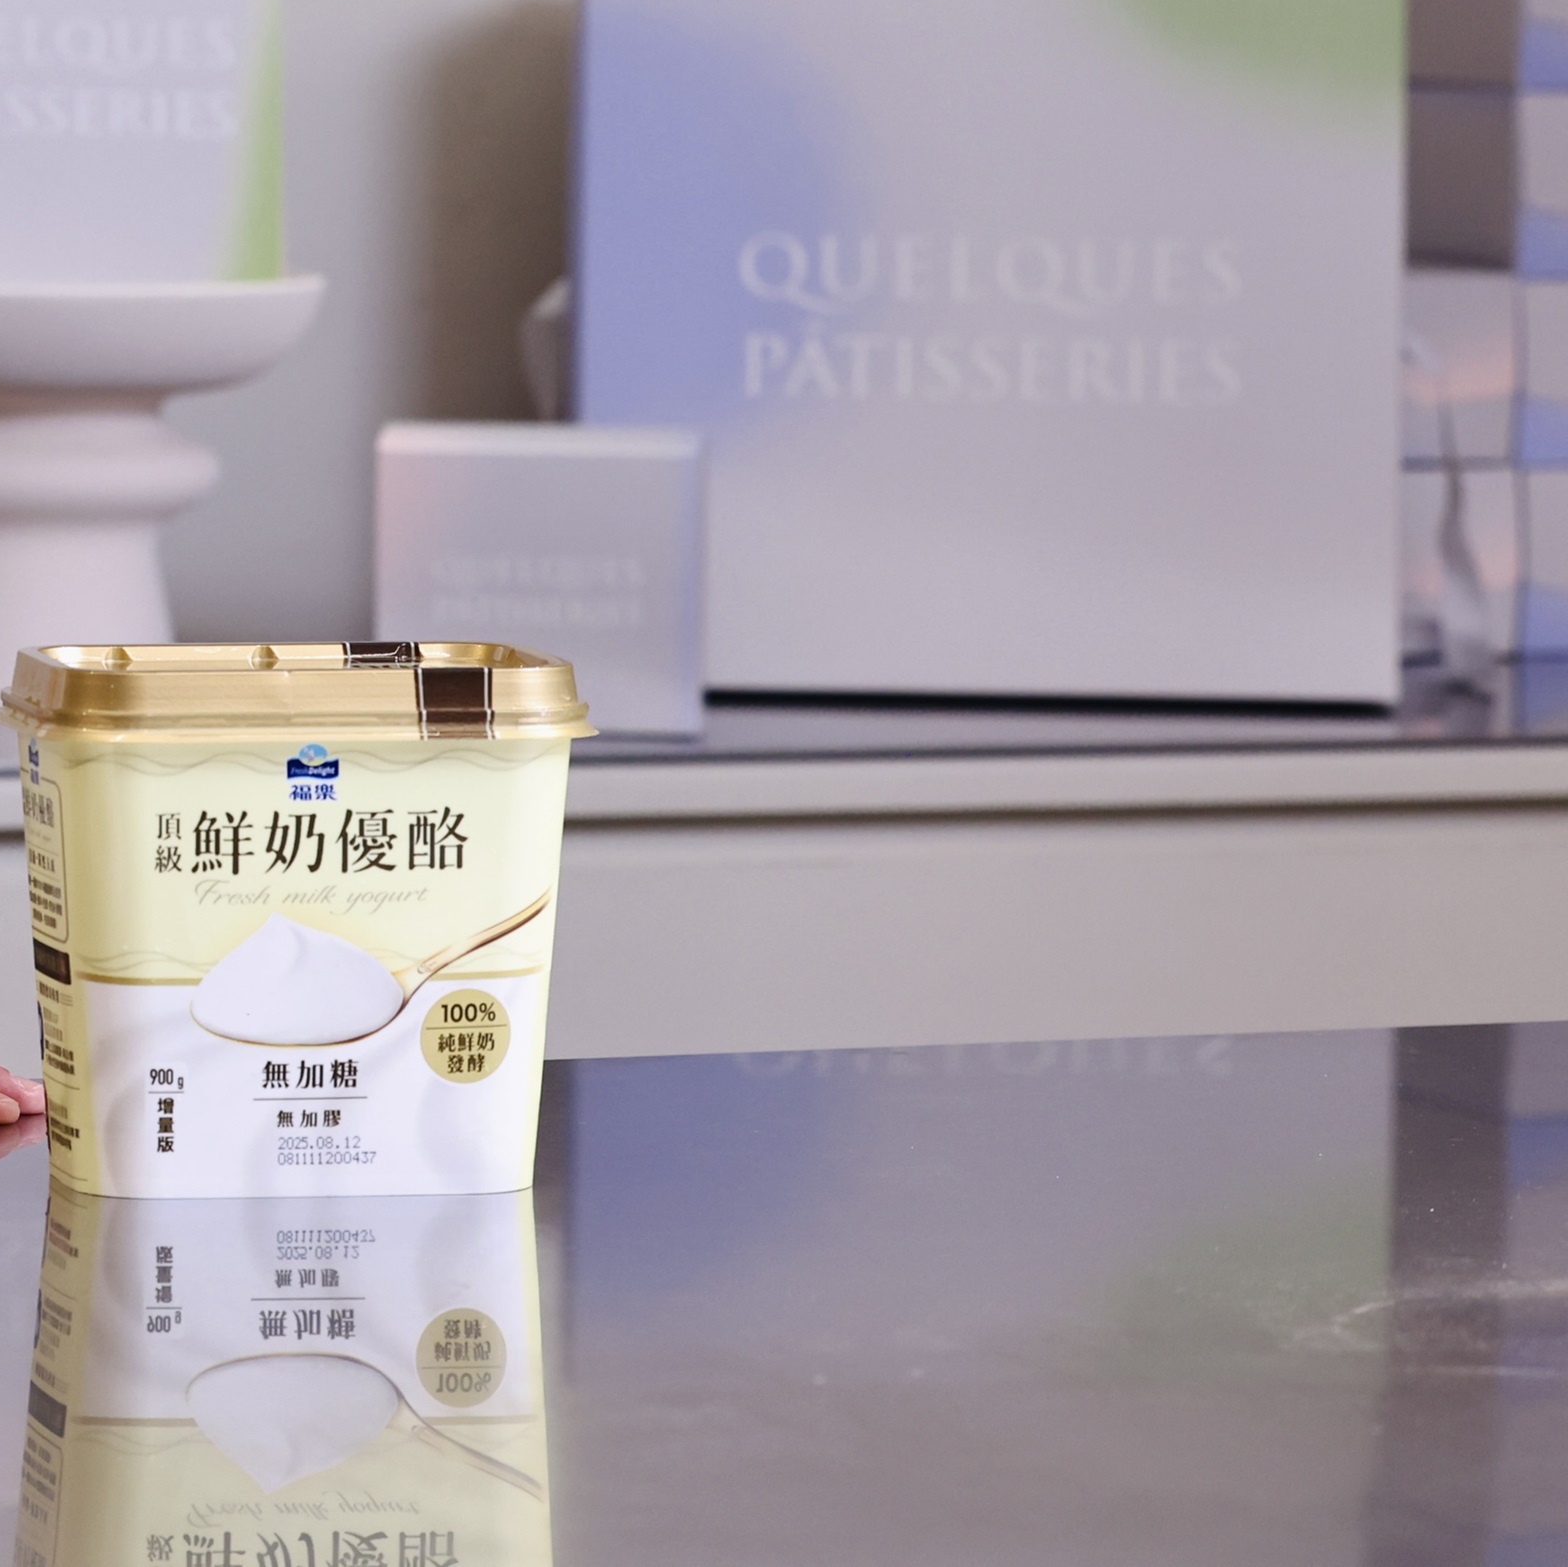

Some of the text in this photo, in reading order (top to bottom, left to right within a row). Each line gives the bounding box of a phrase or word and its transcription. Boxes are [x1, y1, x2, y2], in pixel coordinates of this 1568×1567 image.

[737, 230, 1245, 318] QUELQUES
[154, 812, 183, 874] 頂級
[191, 806, 469, 875] 鮮奶優酪
[194, 879, 430, 915] Fresh milk yogurt
[440, 1002, 497, 1023] 100%
[437, 1032, 496, 1053] 純鮮奶
[261, 1059, 360, 1089] 無加糖
[446, 1053, 487, 1074] 發酵
[149, 1068, 174, 1087] 900
[157, 1097, 175, 1153] 增量版
[276, 1109, 342, 1128] 無加膠
[277, 1136, 361, 1151] 2025.08.12
